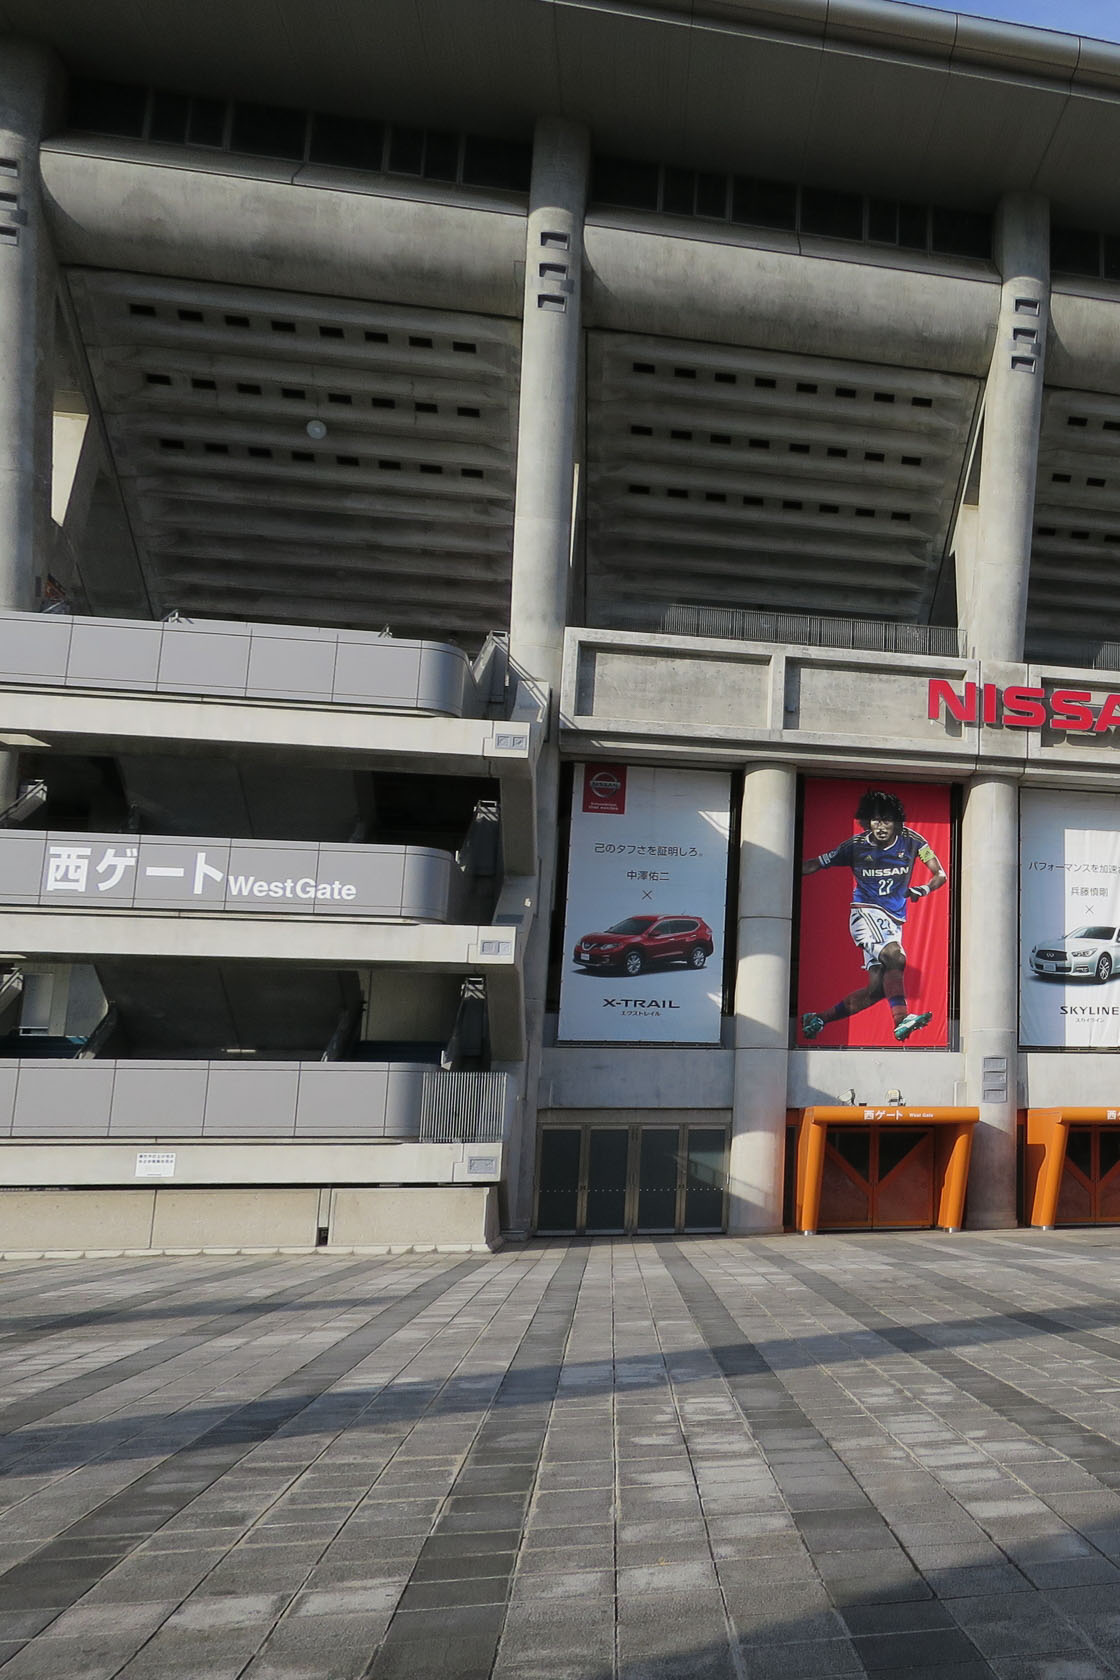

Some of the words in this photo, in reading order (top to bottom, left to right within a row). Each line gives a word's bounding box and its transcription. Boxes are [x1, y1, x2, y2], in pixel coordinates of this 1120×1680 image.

[46, 846, 224, 895] 西ゲート
[862, 866, 910, 877] NISSAN
[602, 998, 681, 1009] X-TRAIL
[1059, 1005, 1119, 1016] SKYLINE
[864, 1109, 903, 1120] 西ゲート
